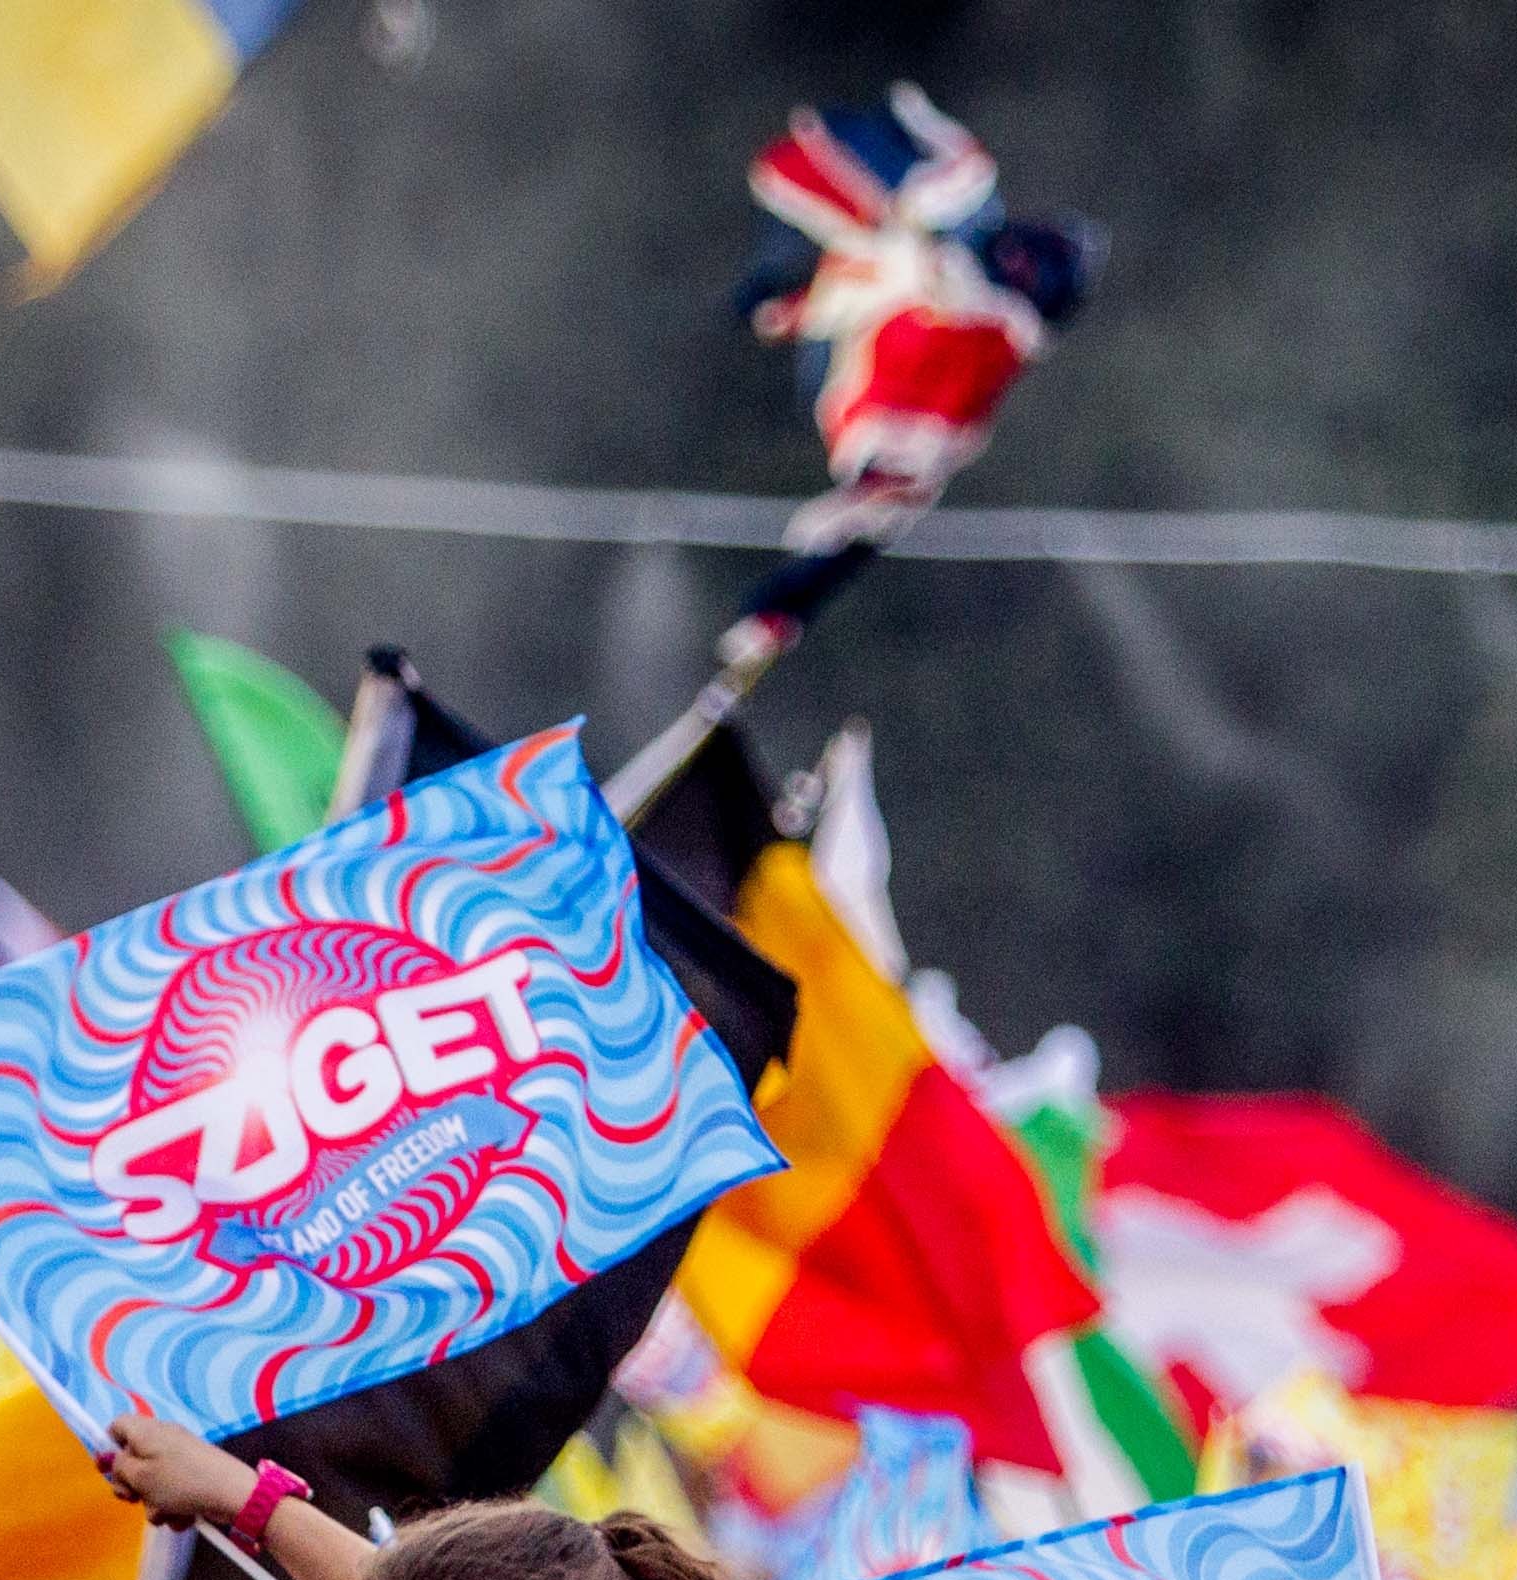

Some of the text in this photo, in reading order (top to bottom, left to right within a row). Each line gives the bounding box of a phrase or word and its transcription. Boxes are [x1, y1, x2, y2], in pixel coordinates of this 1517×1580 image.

[90, 949, 541, 1241] SZIGET
[336, 1178, 371, 1223] OF
[365, 1114, 470, 1197] FREEDOM
